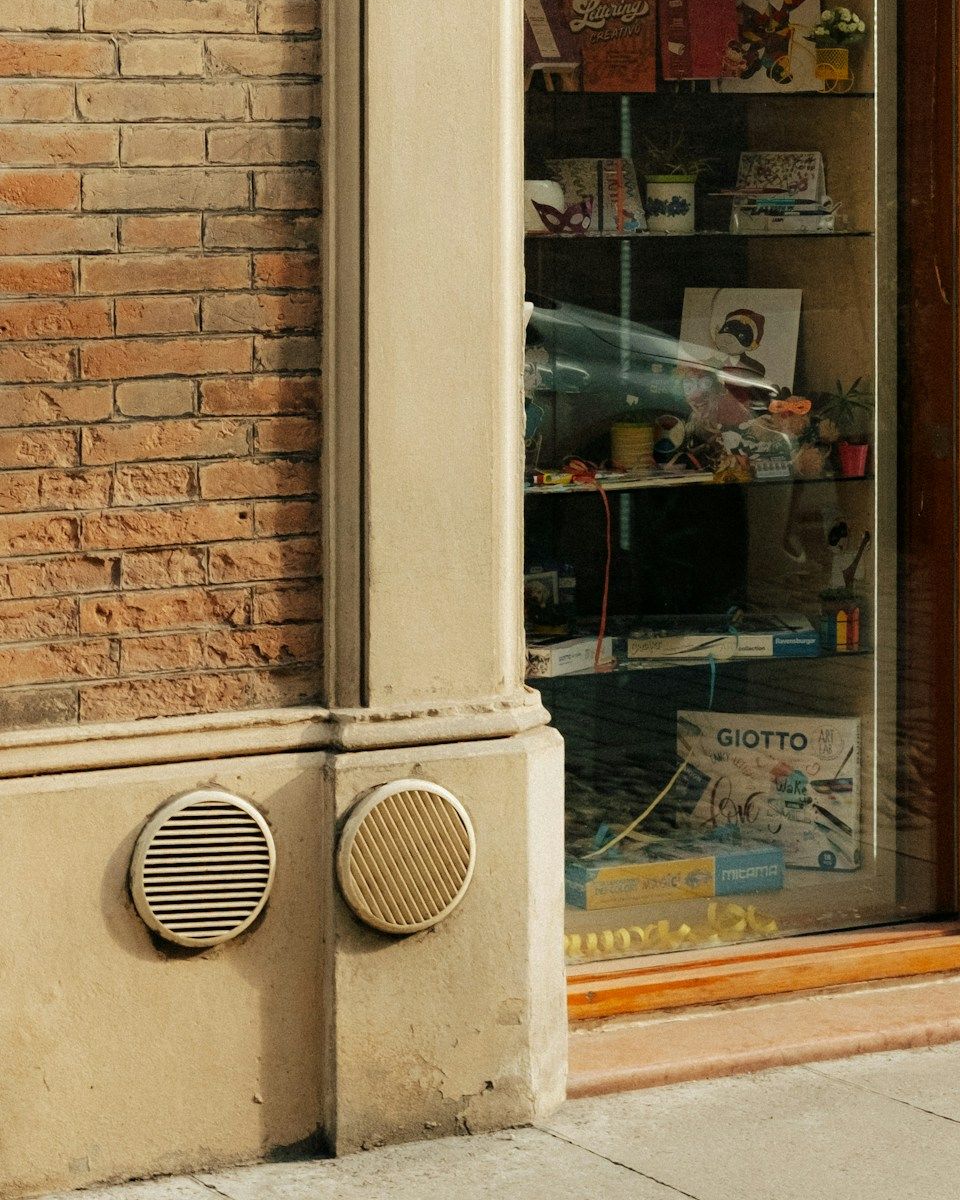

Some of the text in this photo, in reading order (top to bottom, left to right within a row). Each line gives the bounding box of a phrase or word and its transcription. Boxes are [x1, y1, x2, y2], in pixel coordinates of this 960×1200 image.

[590, 24, 640, 43] CREATIVO
[775, 637, 816, 646] Ravensburger
[717, 728, 808, 751] GIOTTO
[721, 864, 778, 882] mitama
